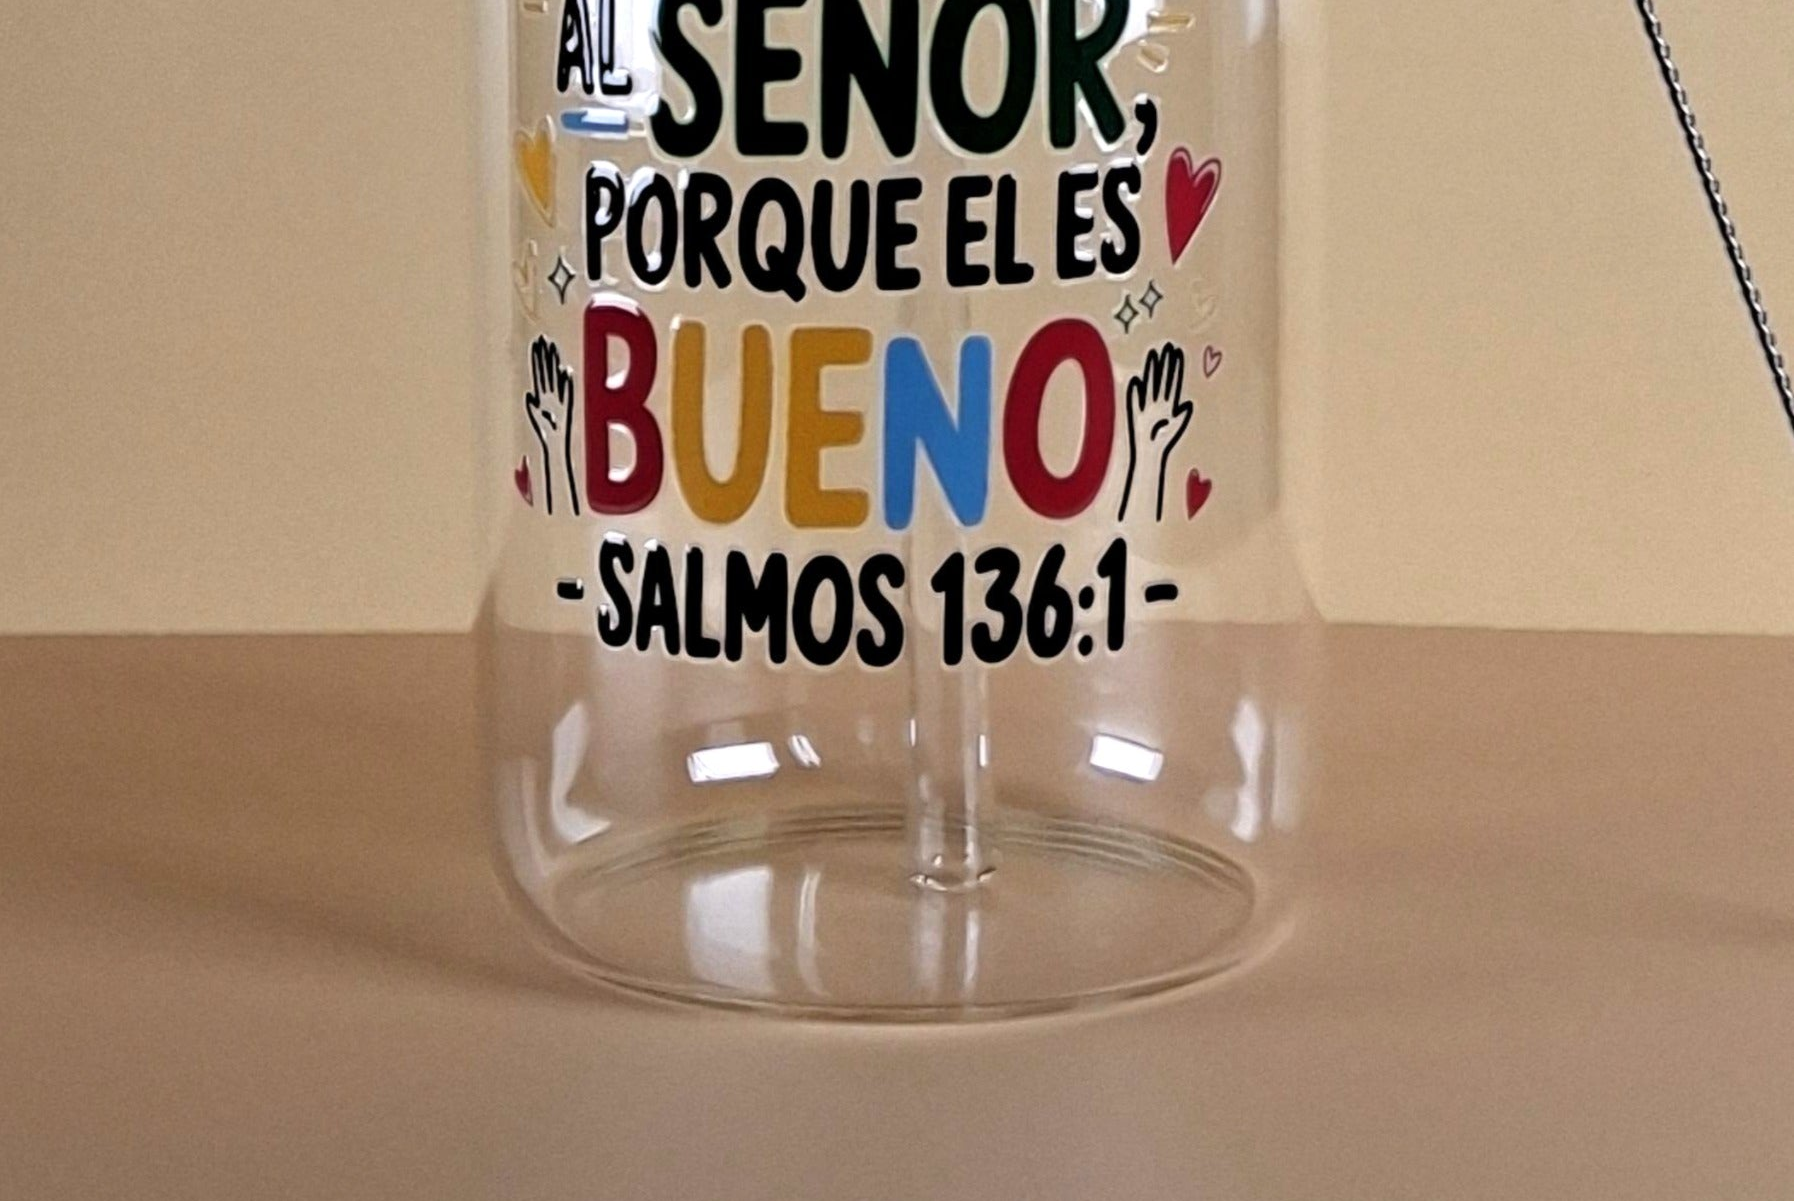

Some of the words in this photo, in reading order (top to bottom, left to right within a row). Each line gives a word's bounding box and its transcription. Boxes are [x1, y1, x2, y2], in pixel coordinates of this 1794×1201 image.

[585, 164, 922, 302] PORQUE
[946, 174, 1034, 286] EL
[1056, 162, 1142, 279] ES
[583, 300, 1116, 529] BUENO
